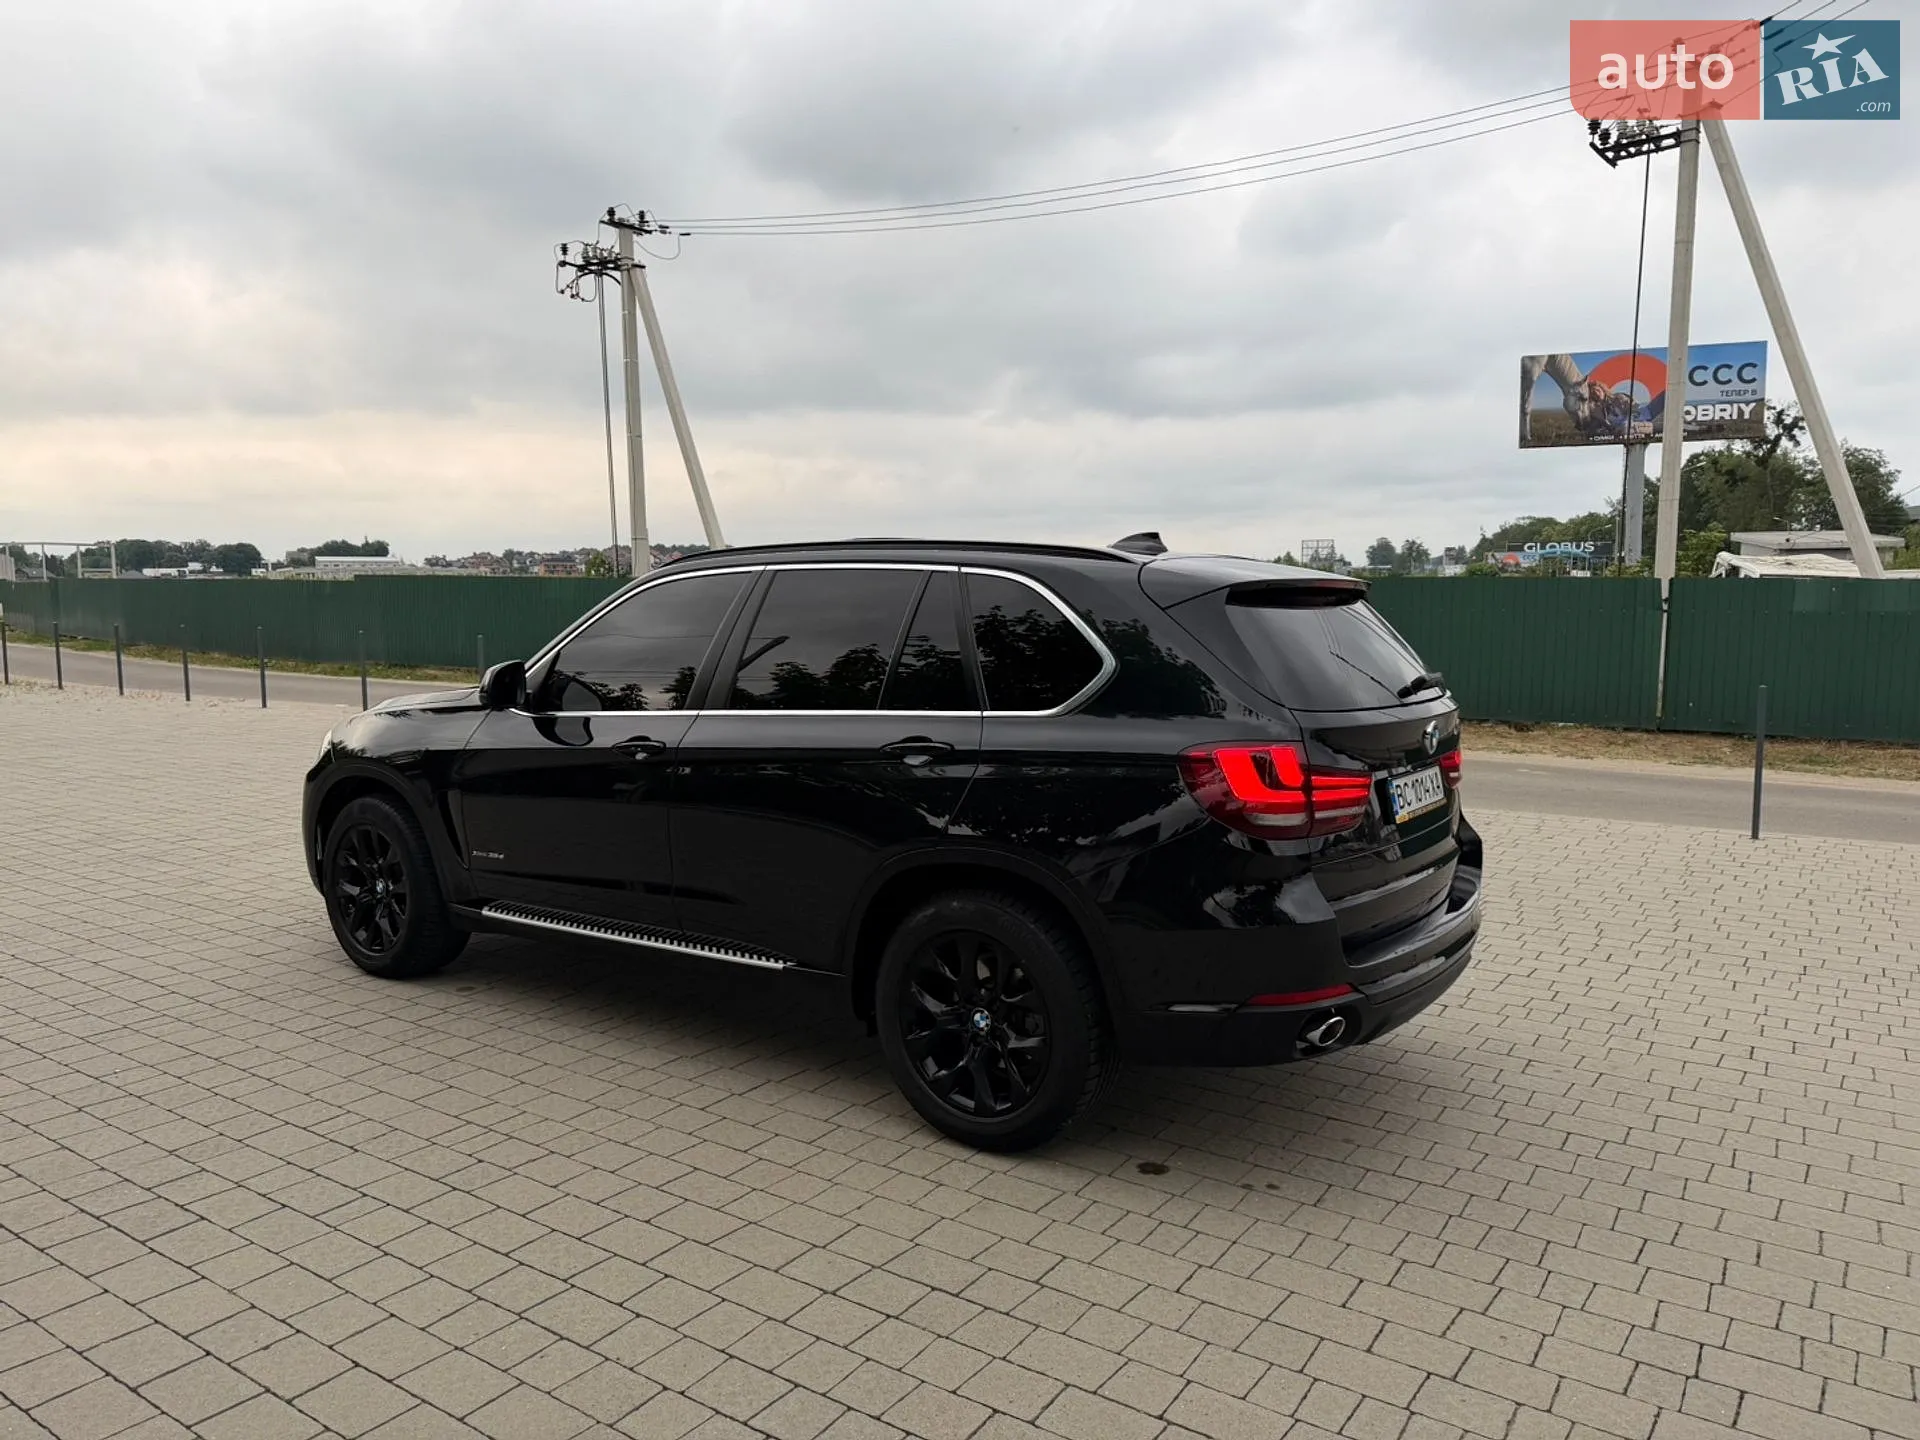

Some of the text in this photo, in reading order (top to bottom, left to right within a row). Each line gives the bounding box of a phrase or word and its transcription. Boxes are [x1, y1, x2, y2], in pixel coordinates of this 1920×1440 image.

[1688, 362, 1758, 387] CCC
[1720, 389, 1749, 398] ТЕПЕР
[1524, 541, 1595, 552] GLOBUS
